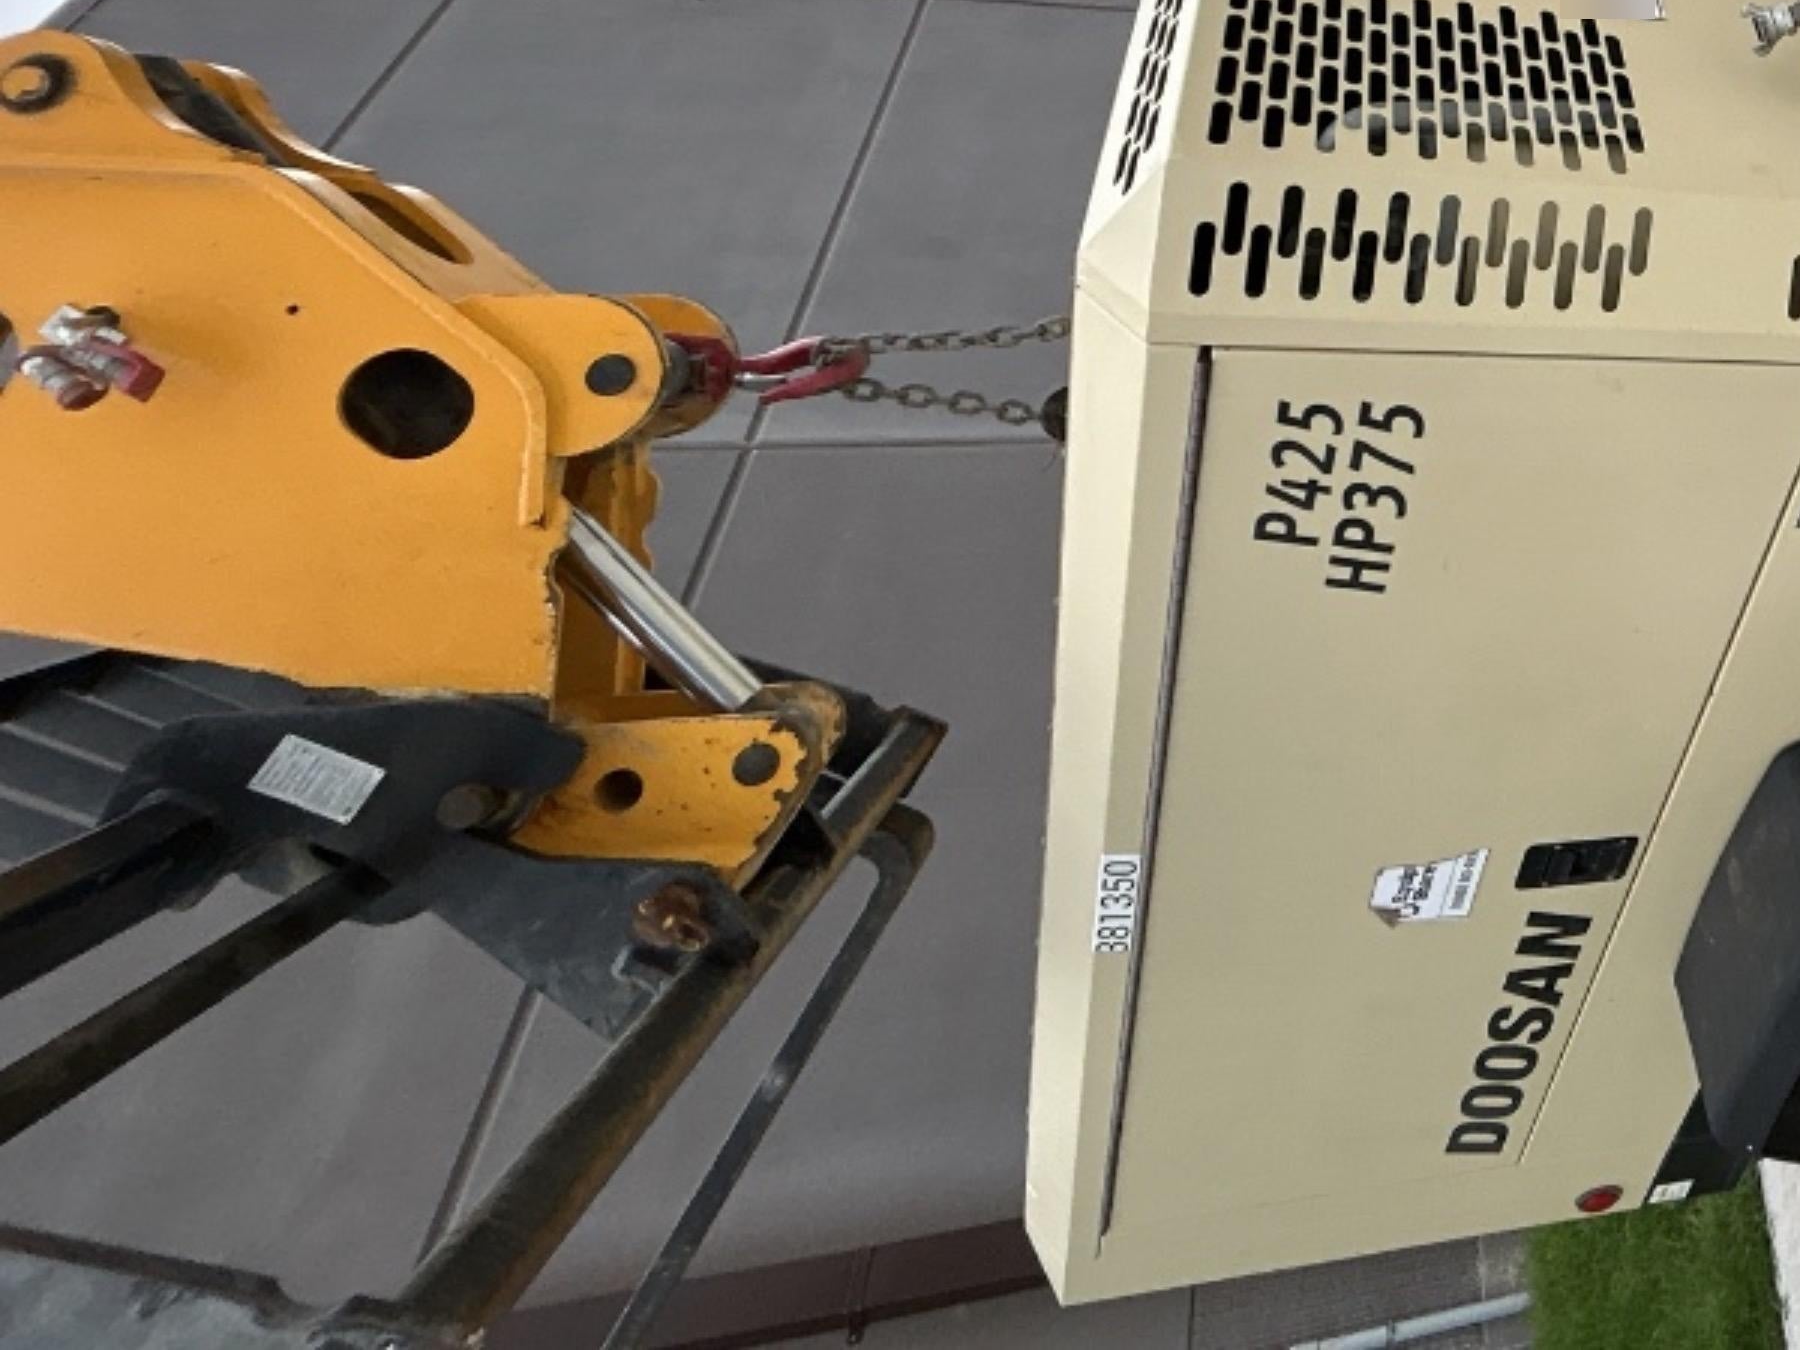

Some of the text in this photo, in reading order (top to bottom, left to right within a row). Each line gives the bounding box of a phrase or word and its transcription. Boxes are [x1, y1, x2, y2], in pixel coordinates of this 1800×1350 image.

[1253, 399, 1344, 547] P425
[1324, 400, 1426, 595] HP375
[1445, 910, 1593, 1153] DOOSAN
